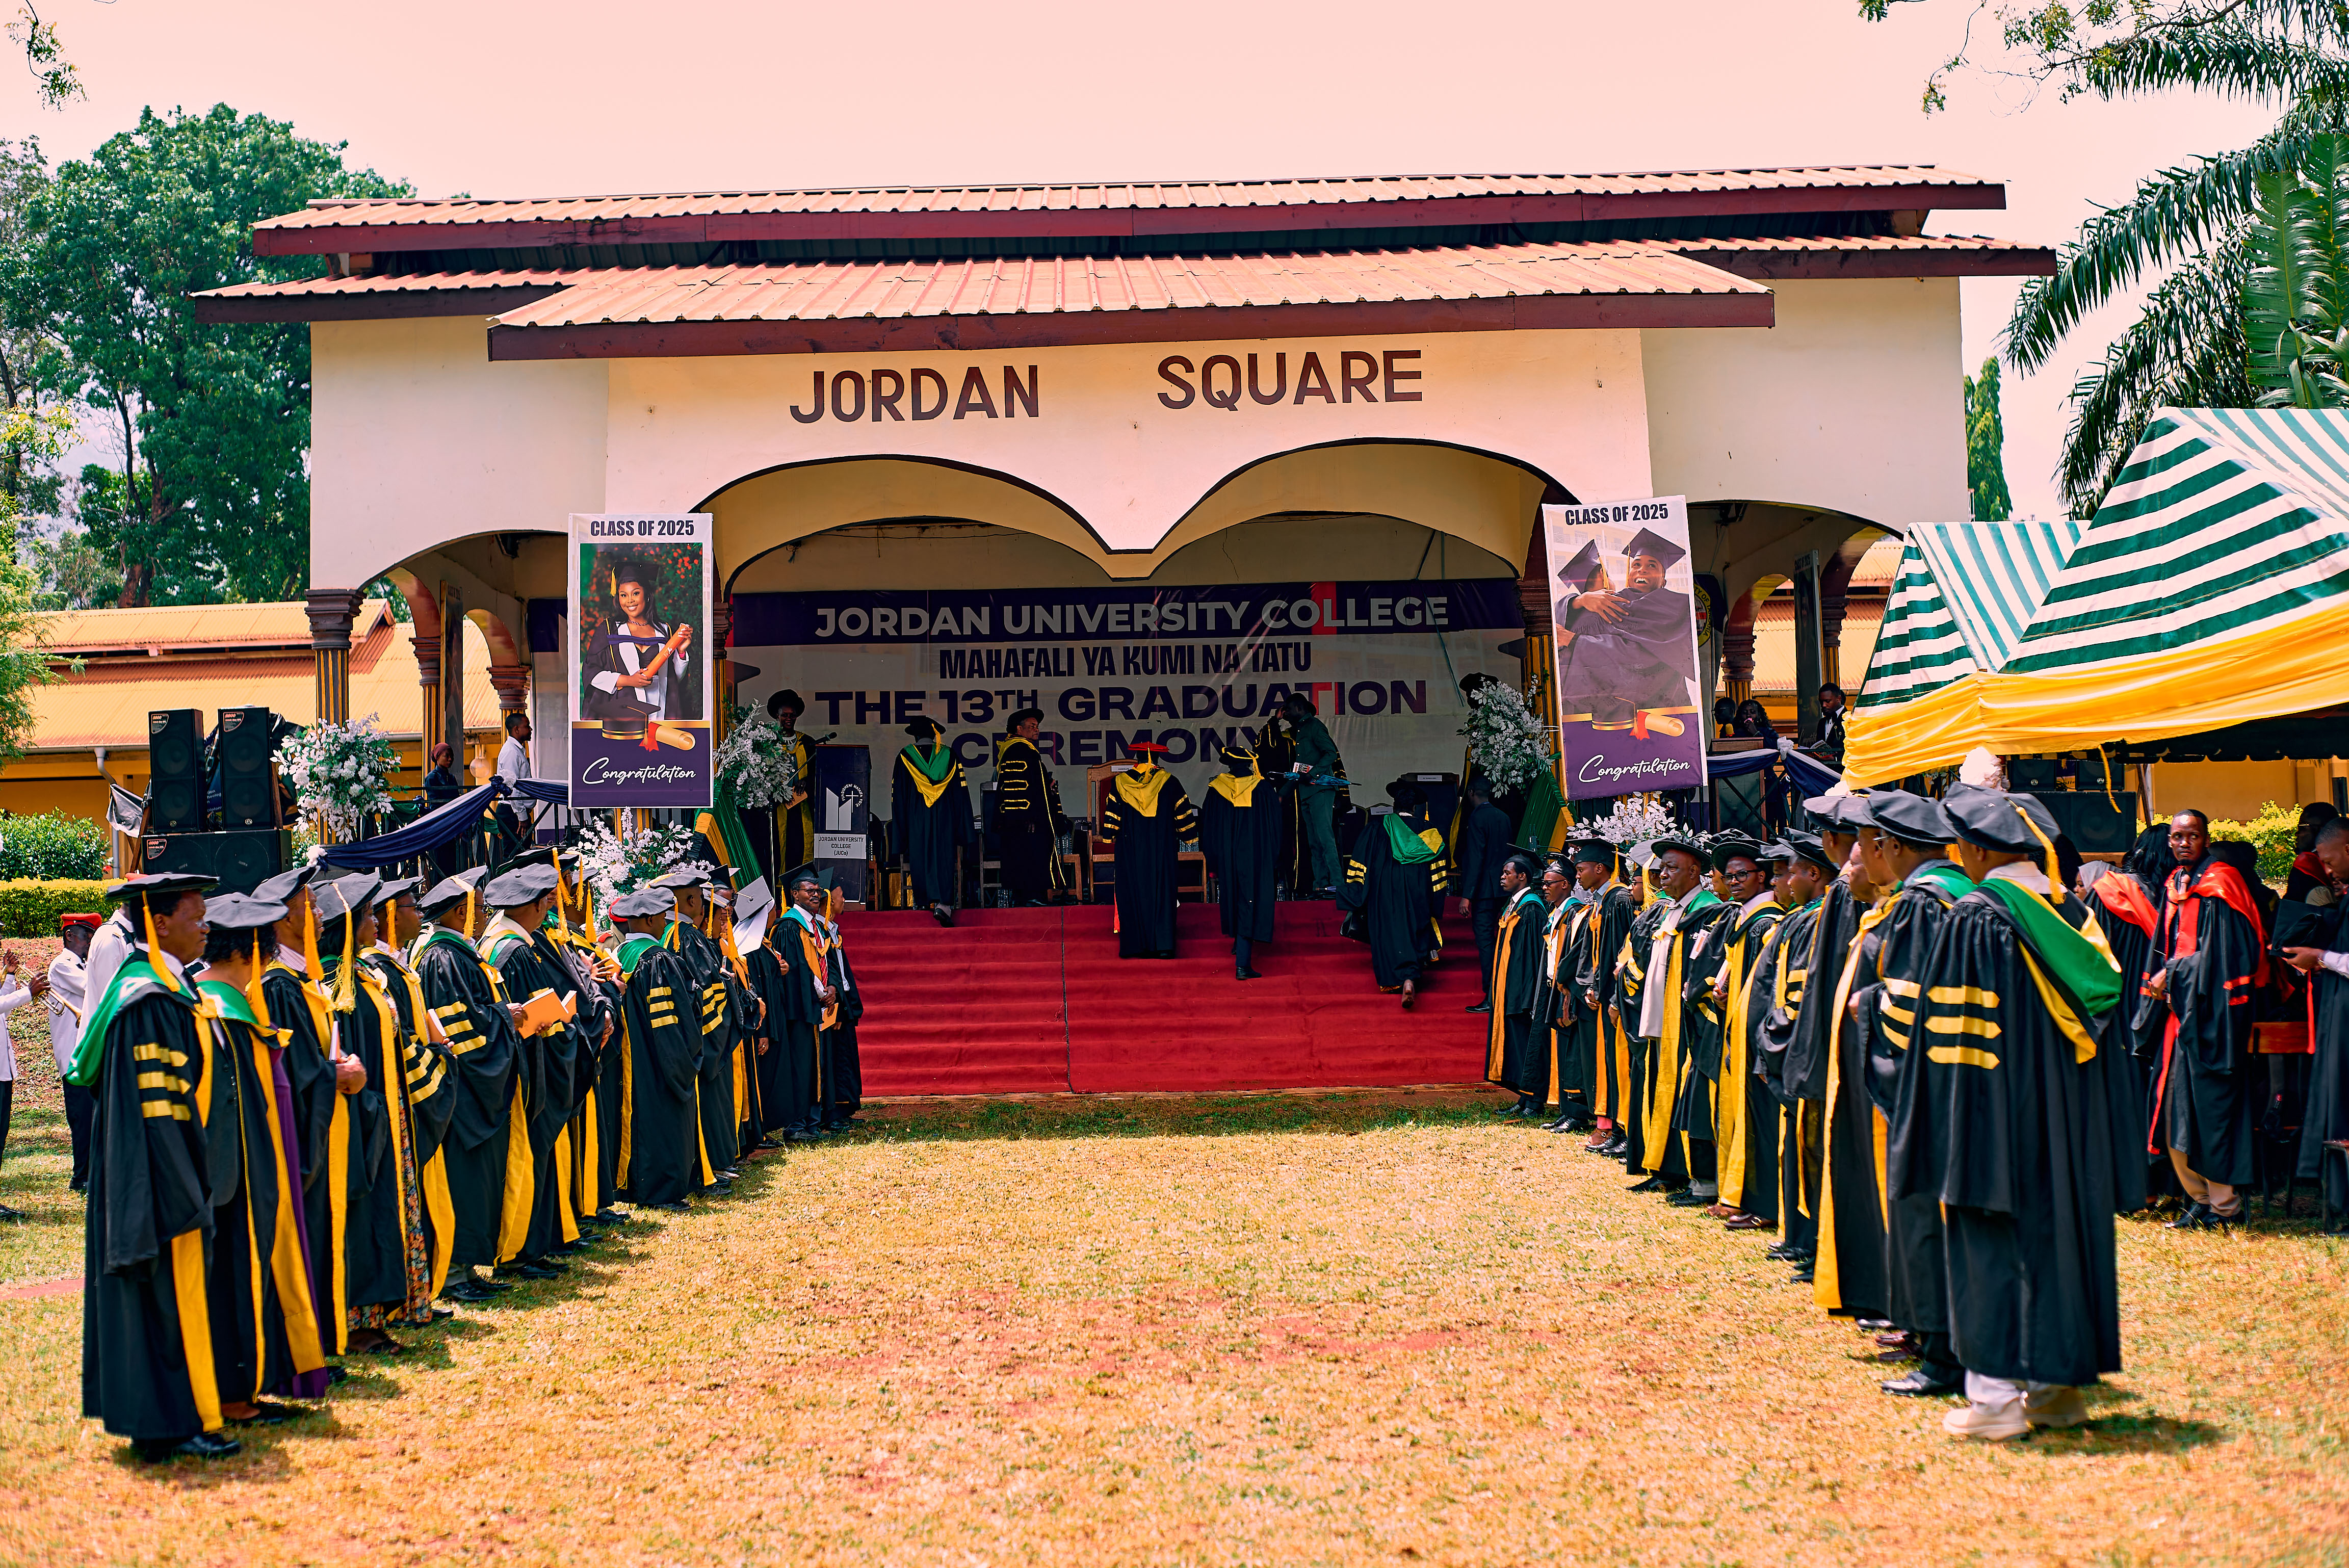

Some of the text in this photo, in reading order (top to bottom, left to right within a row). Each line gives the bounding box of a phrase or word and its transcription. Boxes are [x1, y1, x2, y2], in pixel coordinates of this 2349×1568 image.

[790, 349, 1423, 424] JORDAN SQUARE
[590, 519, 694, 536] CLASS OF 2025
[1565, 503, 1668, 526] CLASS OF 2025
[815, 596, 1449, 637] JORDAN UNIVERSITY COLLEGE
[939, 642, 1312, 679] MAHAFALI YA KUMI NA TATU
[815, 680, 1427, 725] THE 13TH GRADUATION
[582, 756, 696, 786] Congratulation
[1578, 754, 1690, 783] Congratulation
